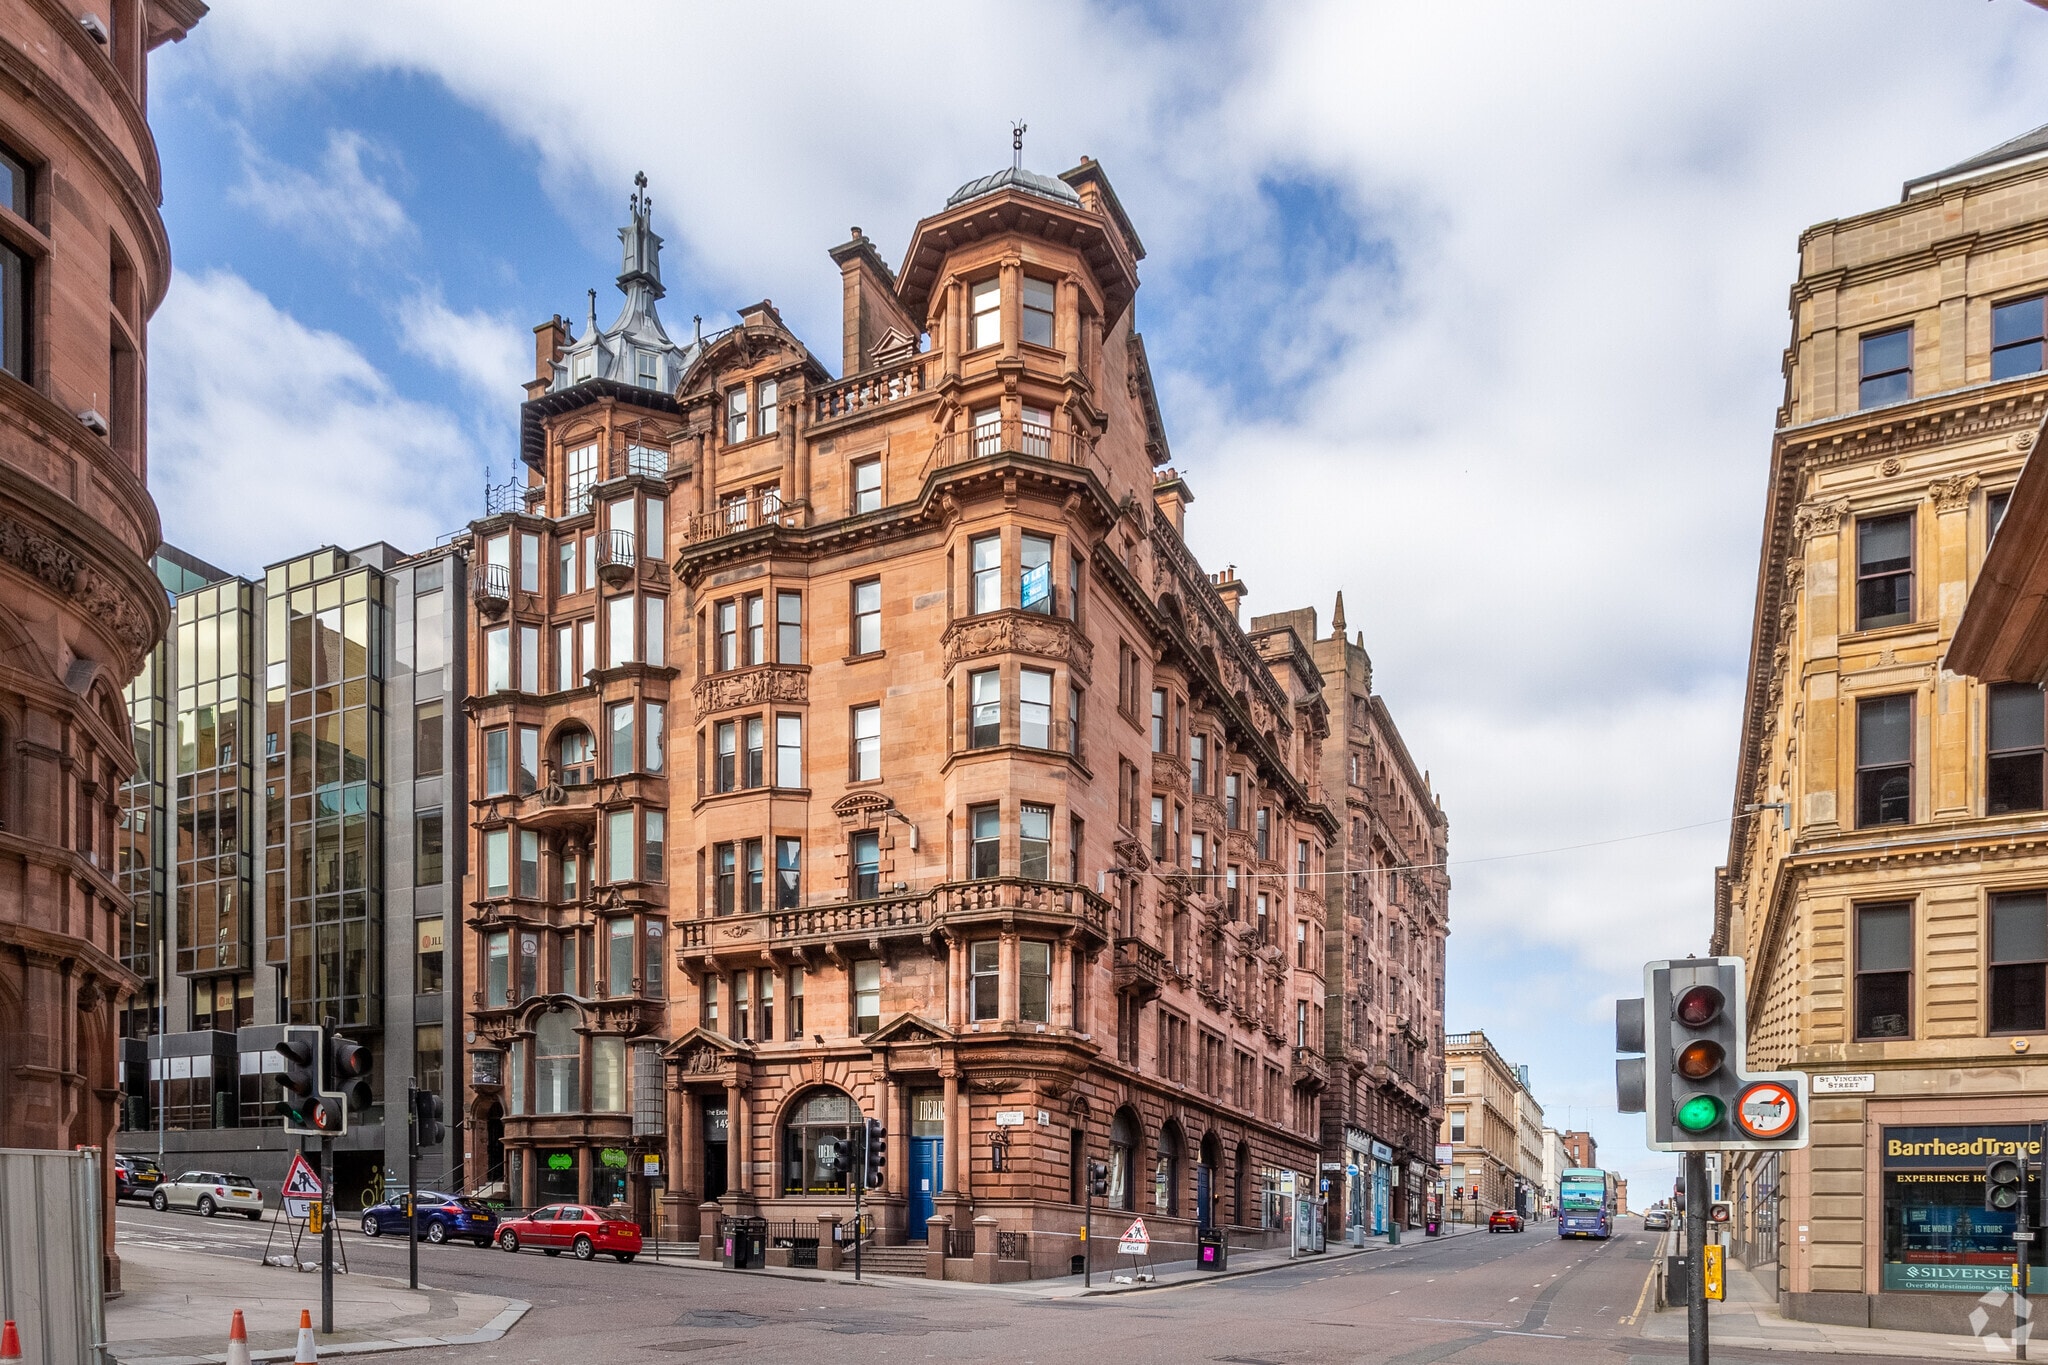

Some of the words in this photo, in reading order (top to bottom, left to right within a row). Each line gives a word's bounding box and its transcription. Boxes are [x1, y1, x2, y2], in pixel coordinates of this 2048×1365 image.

[715, 1108, 728, 1116] Exch
[1897, 1174, 1970, 1183] EXPERIENCE
[1920, 1224, 1931, 1233] THE
[1932, 1224, 1953, 1233] WORLD
[1975, 1225, 1981, 1233] IS
[1983, 1225, 2003, 1233] YOURS
[1921, 1267, 2012, 1280] SILVERSE
[1940, 1282, 1984, 1290] destinations
